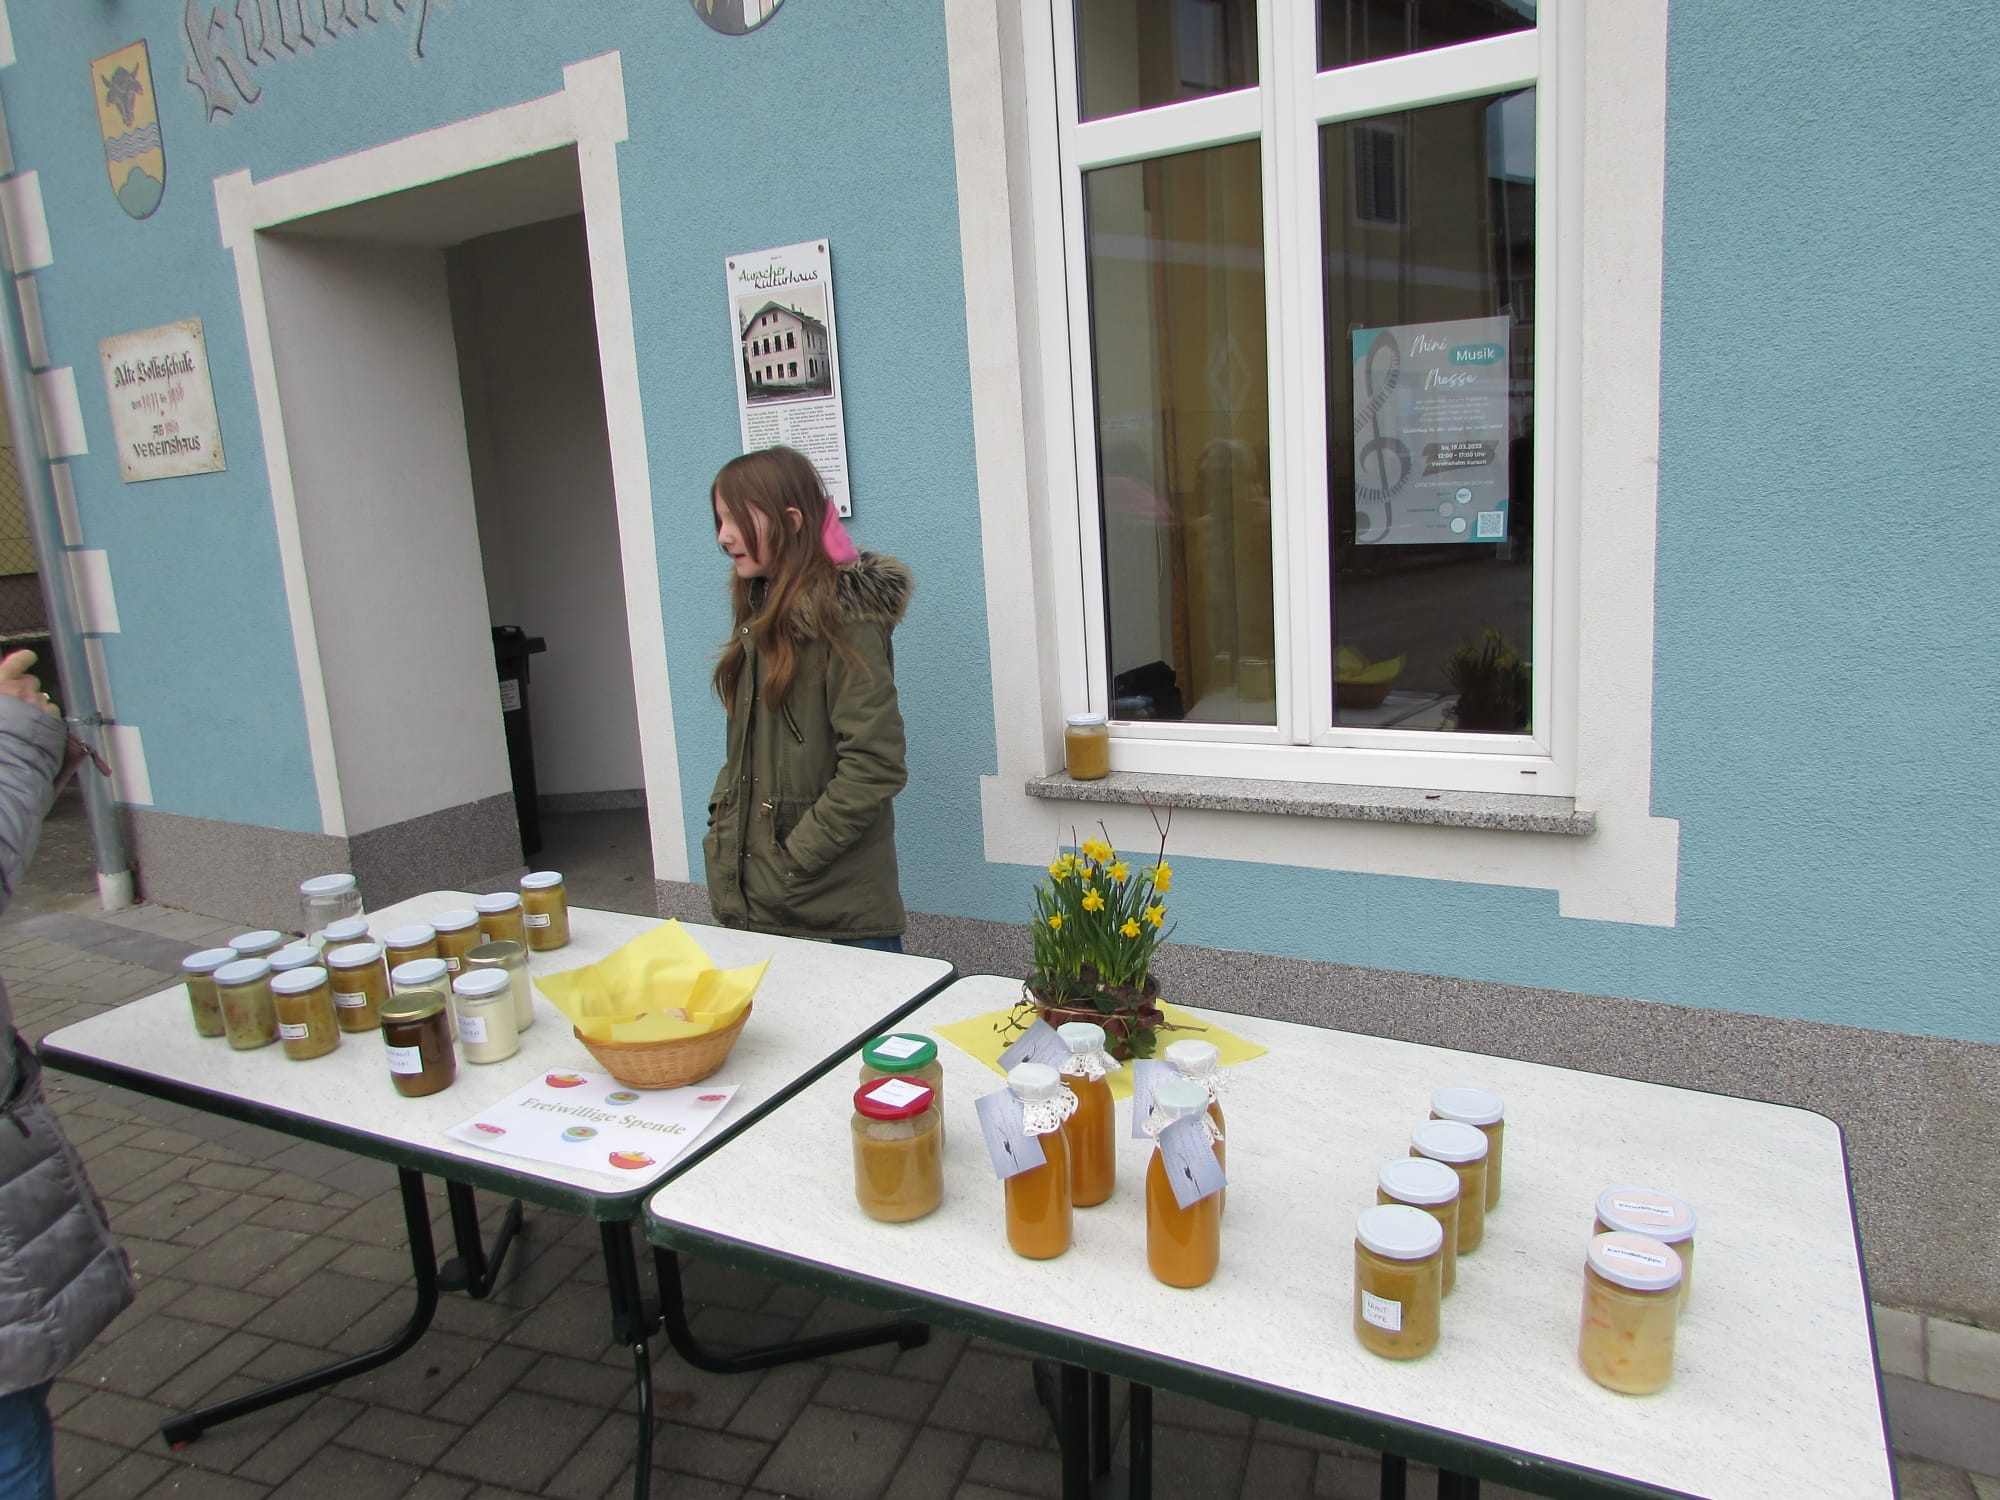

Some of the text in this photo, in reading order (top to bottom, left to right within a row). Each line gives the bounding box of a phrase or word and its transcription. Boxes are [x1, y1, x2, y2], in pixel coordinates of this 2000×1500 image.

[739, 264, 787, 282] Auracher
[755, 270, 818, 289] Kulturhaus
[1410, 333, 1448, 358] Mini
[1456, 347, 1496, 362] Musik
[520, 1096, 687, 1136] Freiwillige Spende
